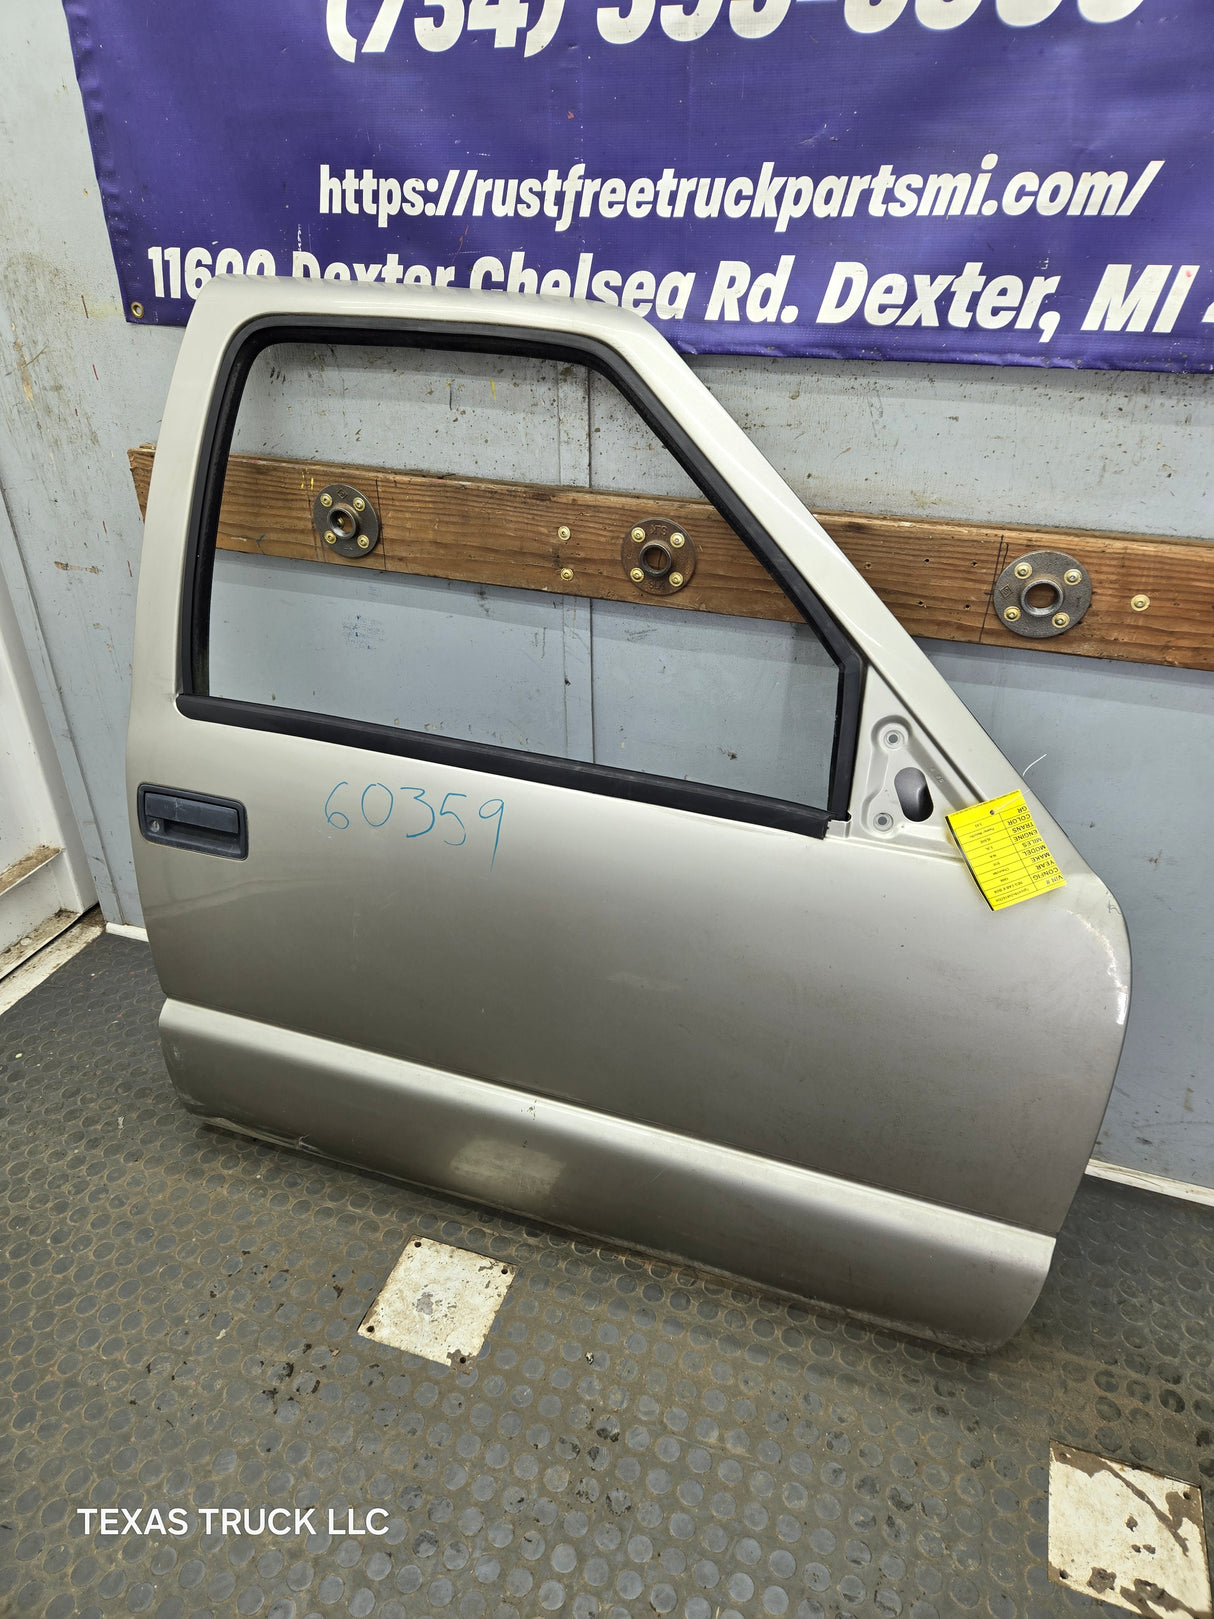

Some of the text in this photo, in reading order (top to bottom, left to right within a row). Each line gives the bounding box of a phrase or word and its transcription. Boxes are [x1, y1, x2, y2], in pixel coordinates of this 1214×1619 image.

[319, 153, 1165, 233] https://rustfreetruckpartsmi.com/
[469, 251, 696, 320] Chelsea
[704, 255, 799, 324] Rd.
[816, 261, 1061, 344] Dexter,
[1080, 264, 1200, 333] MI
[1017, 805, 1027, 813] GR
[1007, 813, 1031, 825] COLOR
[325, 781, 504, 872] 60359
[1012, 821, 1034, 833] TRANS
[1013, 829, 1038, 842] ENGINE
[1021, 836, 1042, 848] MILES
[1022, 844, 1046, 856] MODEL
[1030, 852, 1050, 862] MAKE
[1035, 859, 1054, 870] YEAR
[1032, 866, 1059, 880] CONFIG
